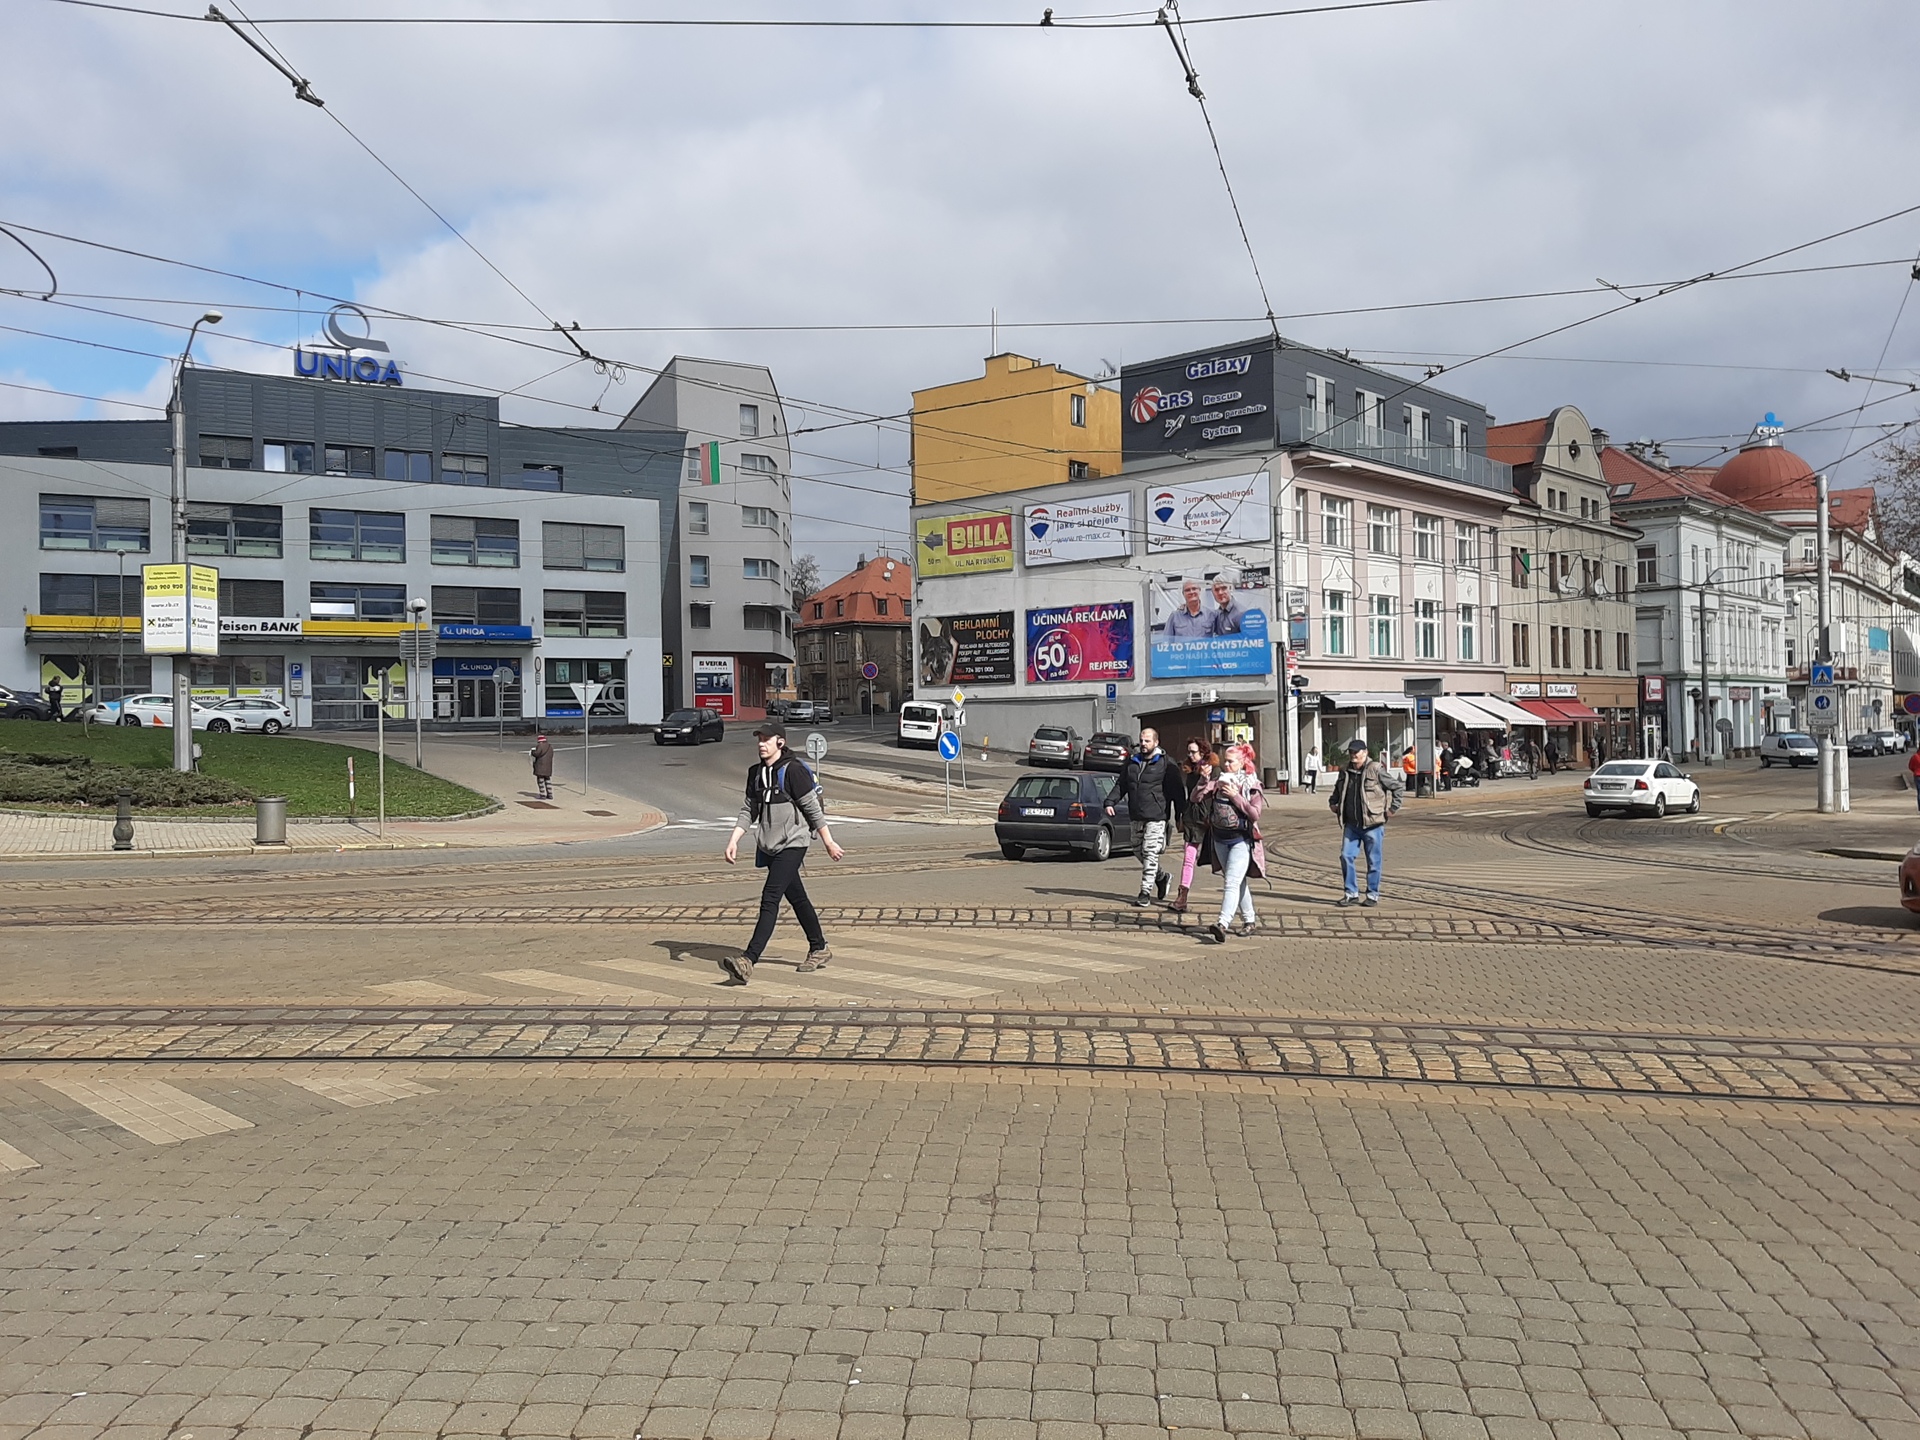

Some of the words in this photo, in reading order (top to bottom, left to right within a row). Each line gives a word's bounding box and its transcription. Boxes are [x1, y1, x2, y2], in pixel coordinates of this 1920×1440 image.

[296, 349, 403, 386] UNIQA
[1186, 354, 1252, 379] Galaxy
[1157, 390, 1193, 411] GRS
[1202, 391, 1242, 406] Rescue
[1224, 404, 1267, 419] parachute
[1202, 425, 1241, 440] System
[1056, 507, 1089, 518] Realitní
[1092, 503, 1124, 514] služby,
[951, 522, 1009, 550] BILLA
[953, 615, 1000, 630] REKLAMNÍ
[1033, 611, 1073, 626] ÚČINNÁ
[1075, 609, 1127, 623] REKLAMA
[220, 620, 257, 631] feisen
[260, 622, 300, 632] BANK
[975, 629, 1010, 640] PLOCHY
[1156, 642, 1169, 652] UŽ
[1171, 642, 1183, 651] TO
[1185, 641, 1211, 650] TADY
[1213, 637, 1265, 650] CHYSTÁME
[1068, 654, 1080, 665] Kč
[292, 664, 301, 675] P
[1108, 685, 1115, 696] P
